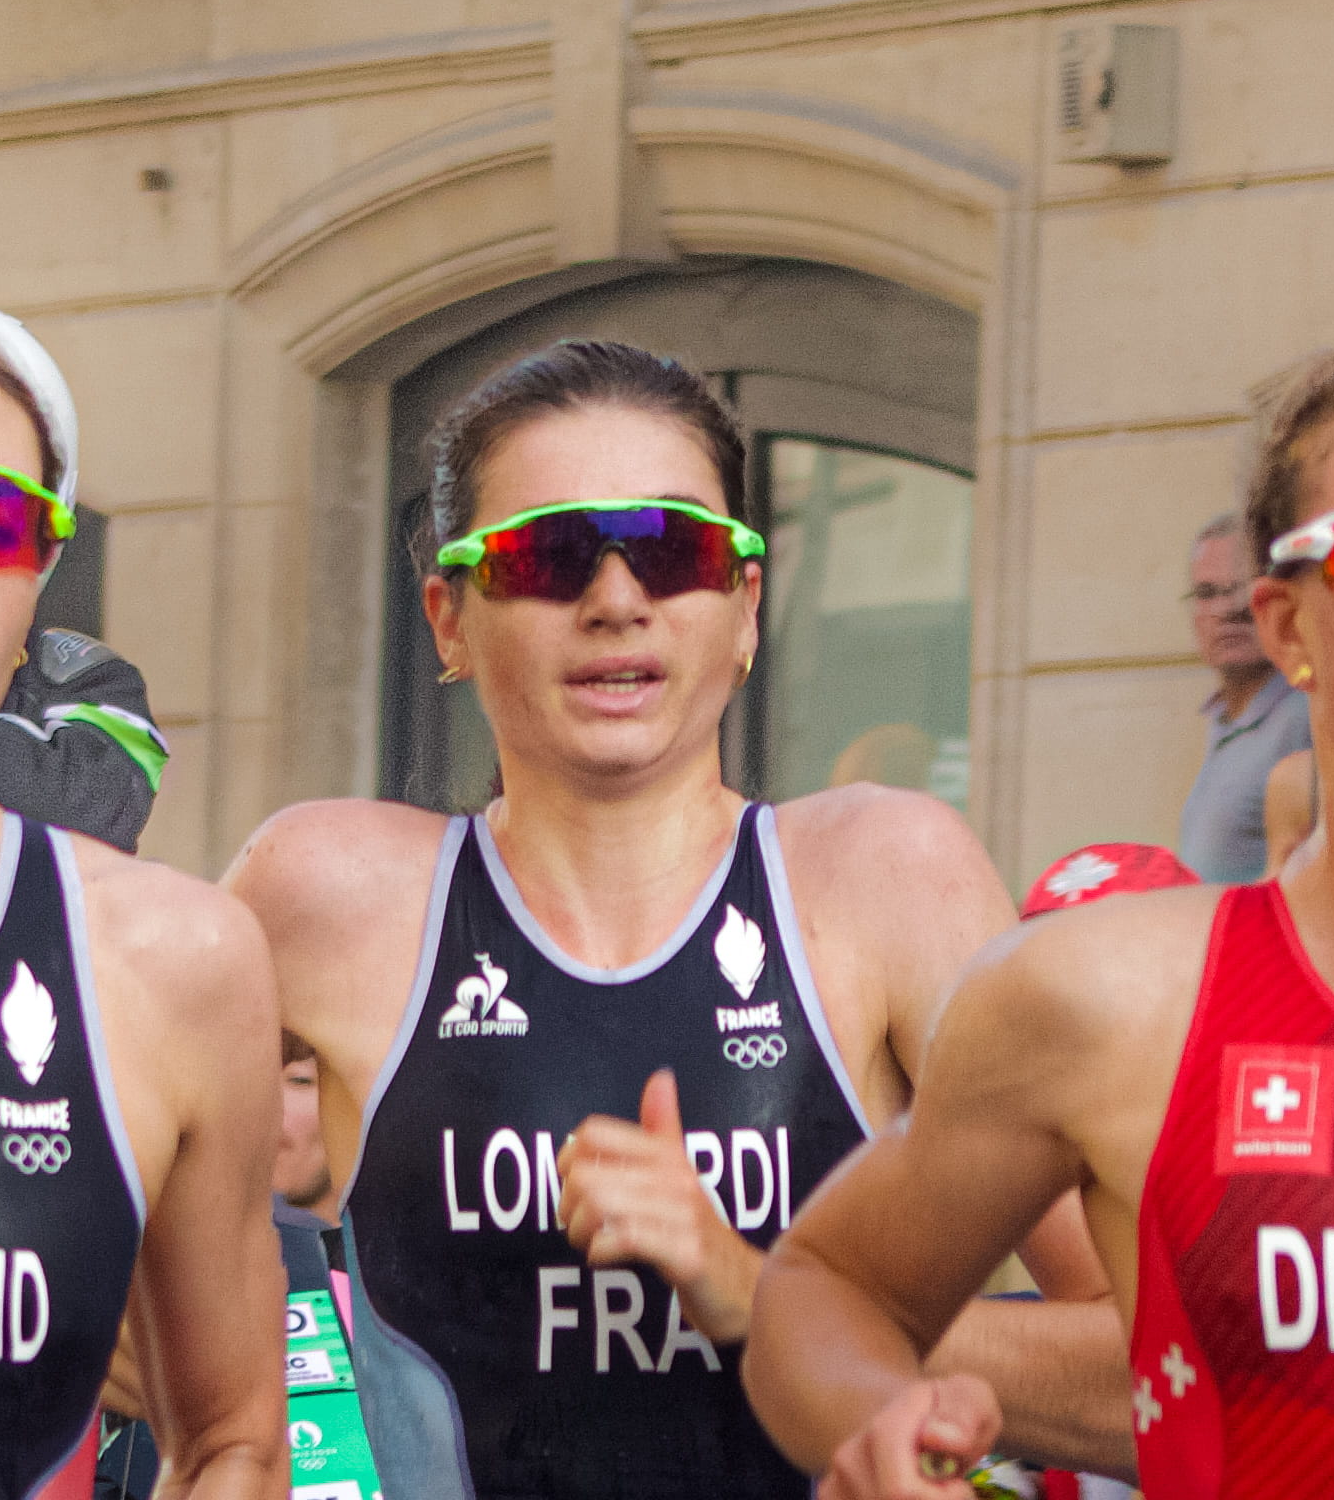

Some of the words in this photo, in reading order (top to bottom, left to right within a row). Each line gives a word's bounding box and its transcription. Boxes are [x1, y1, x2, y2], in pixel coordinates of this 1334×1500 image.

[716, 1001, 782, 1033] FRANCE
[443, 1127, 791, 1233] LOMRDI
[537, 1265, 723, 1374] FRA
